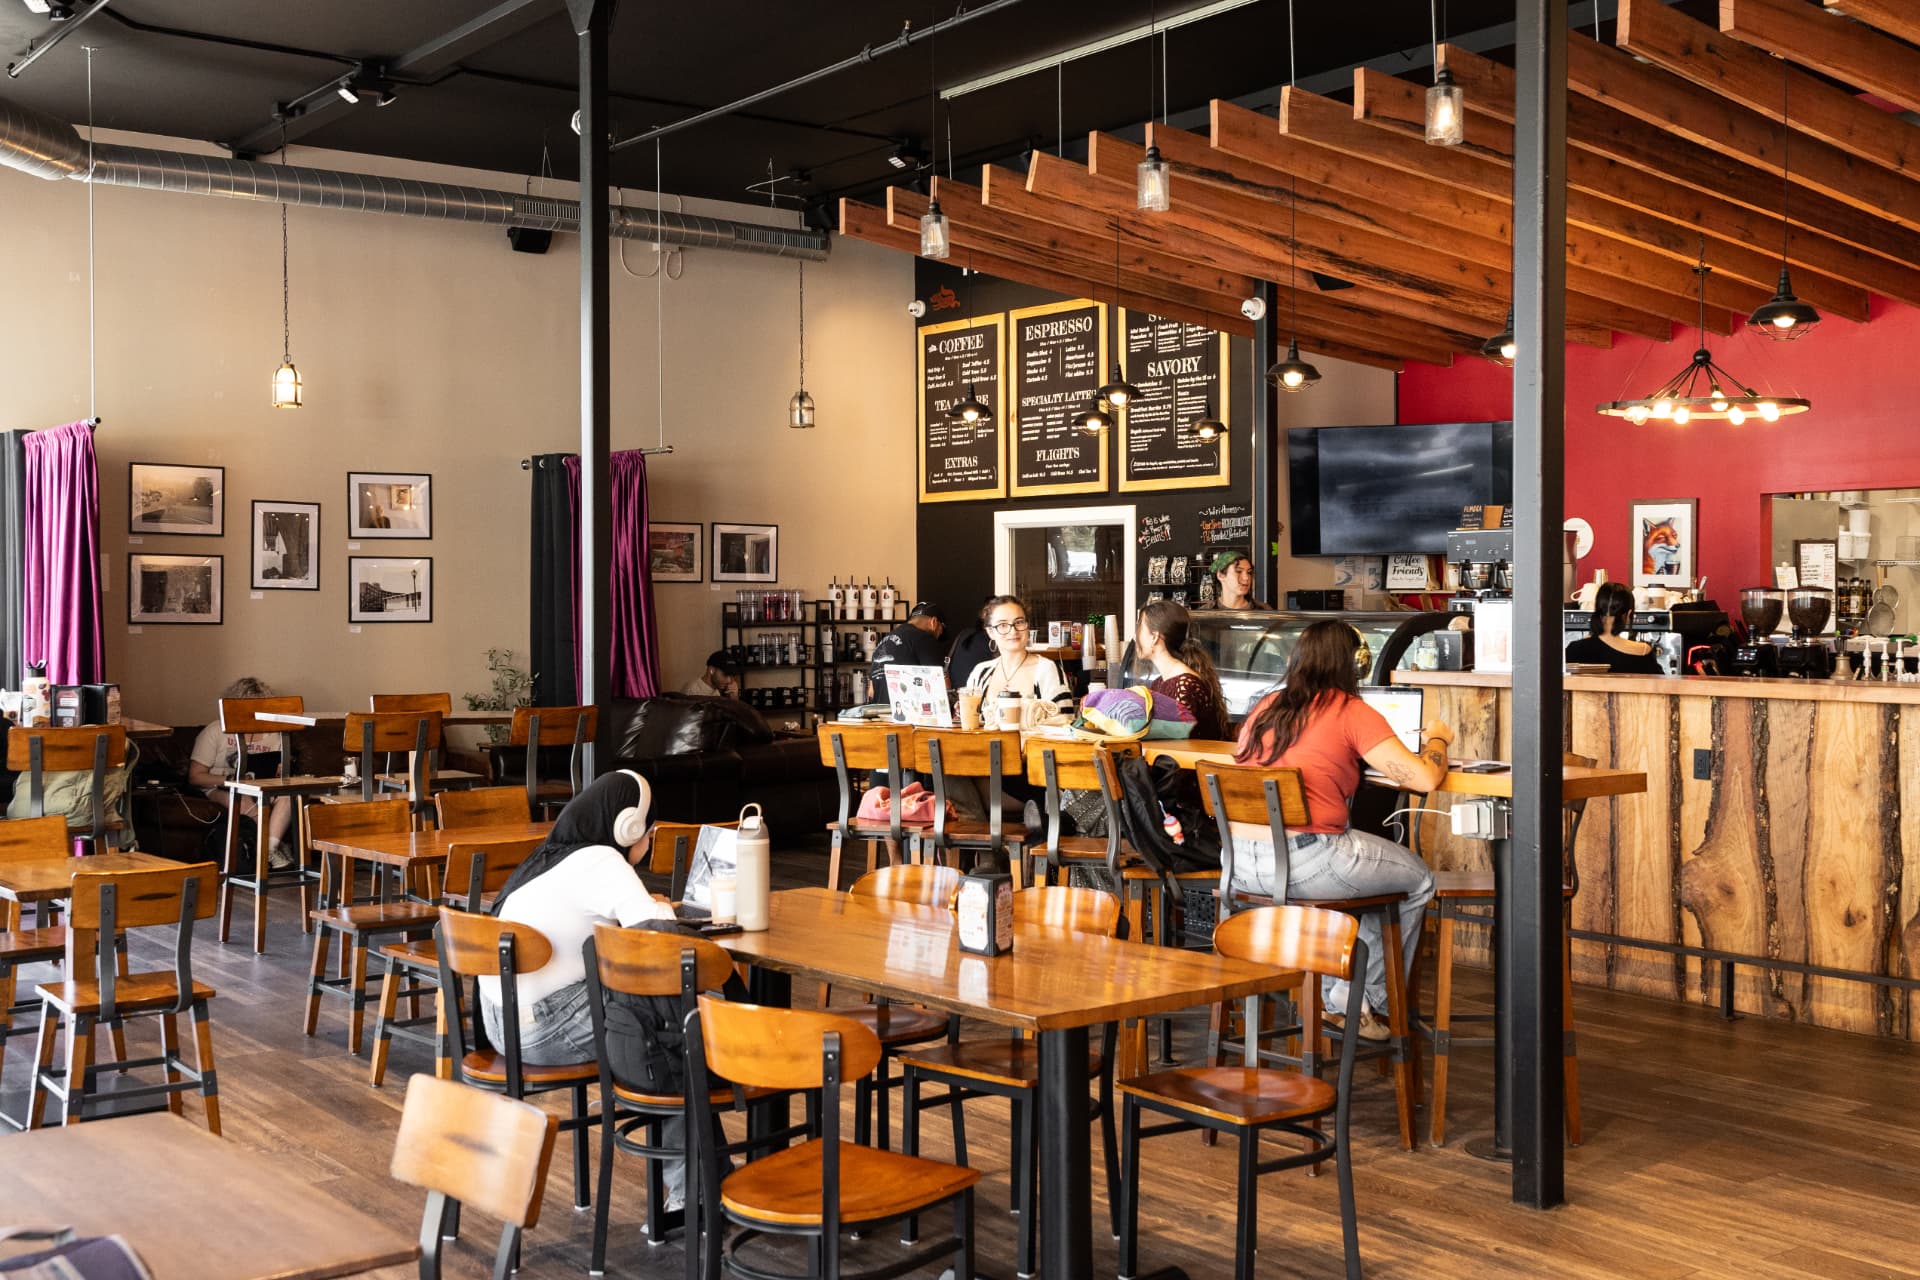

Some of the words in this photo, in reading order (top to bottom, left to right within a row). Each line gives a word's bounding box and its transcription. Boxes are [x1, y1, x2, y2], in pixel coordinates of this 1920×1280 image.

[1025, 316, 1093, 341] ESPRESSO
[939, 334, 984, 354] COFFEE
[1147, 356, 1202, 377] SAVORY
[934, 399, 951, 412] TEA
[1022, 393, 1064, 407] SPECIALTY
[1036, 447, 1080, 462] FLIGHTS
[944, 456, 978, 469] EXTRAS
[1393, 554, 1420, 566] Coffee
